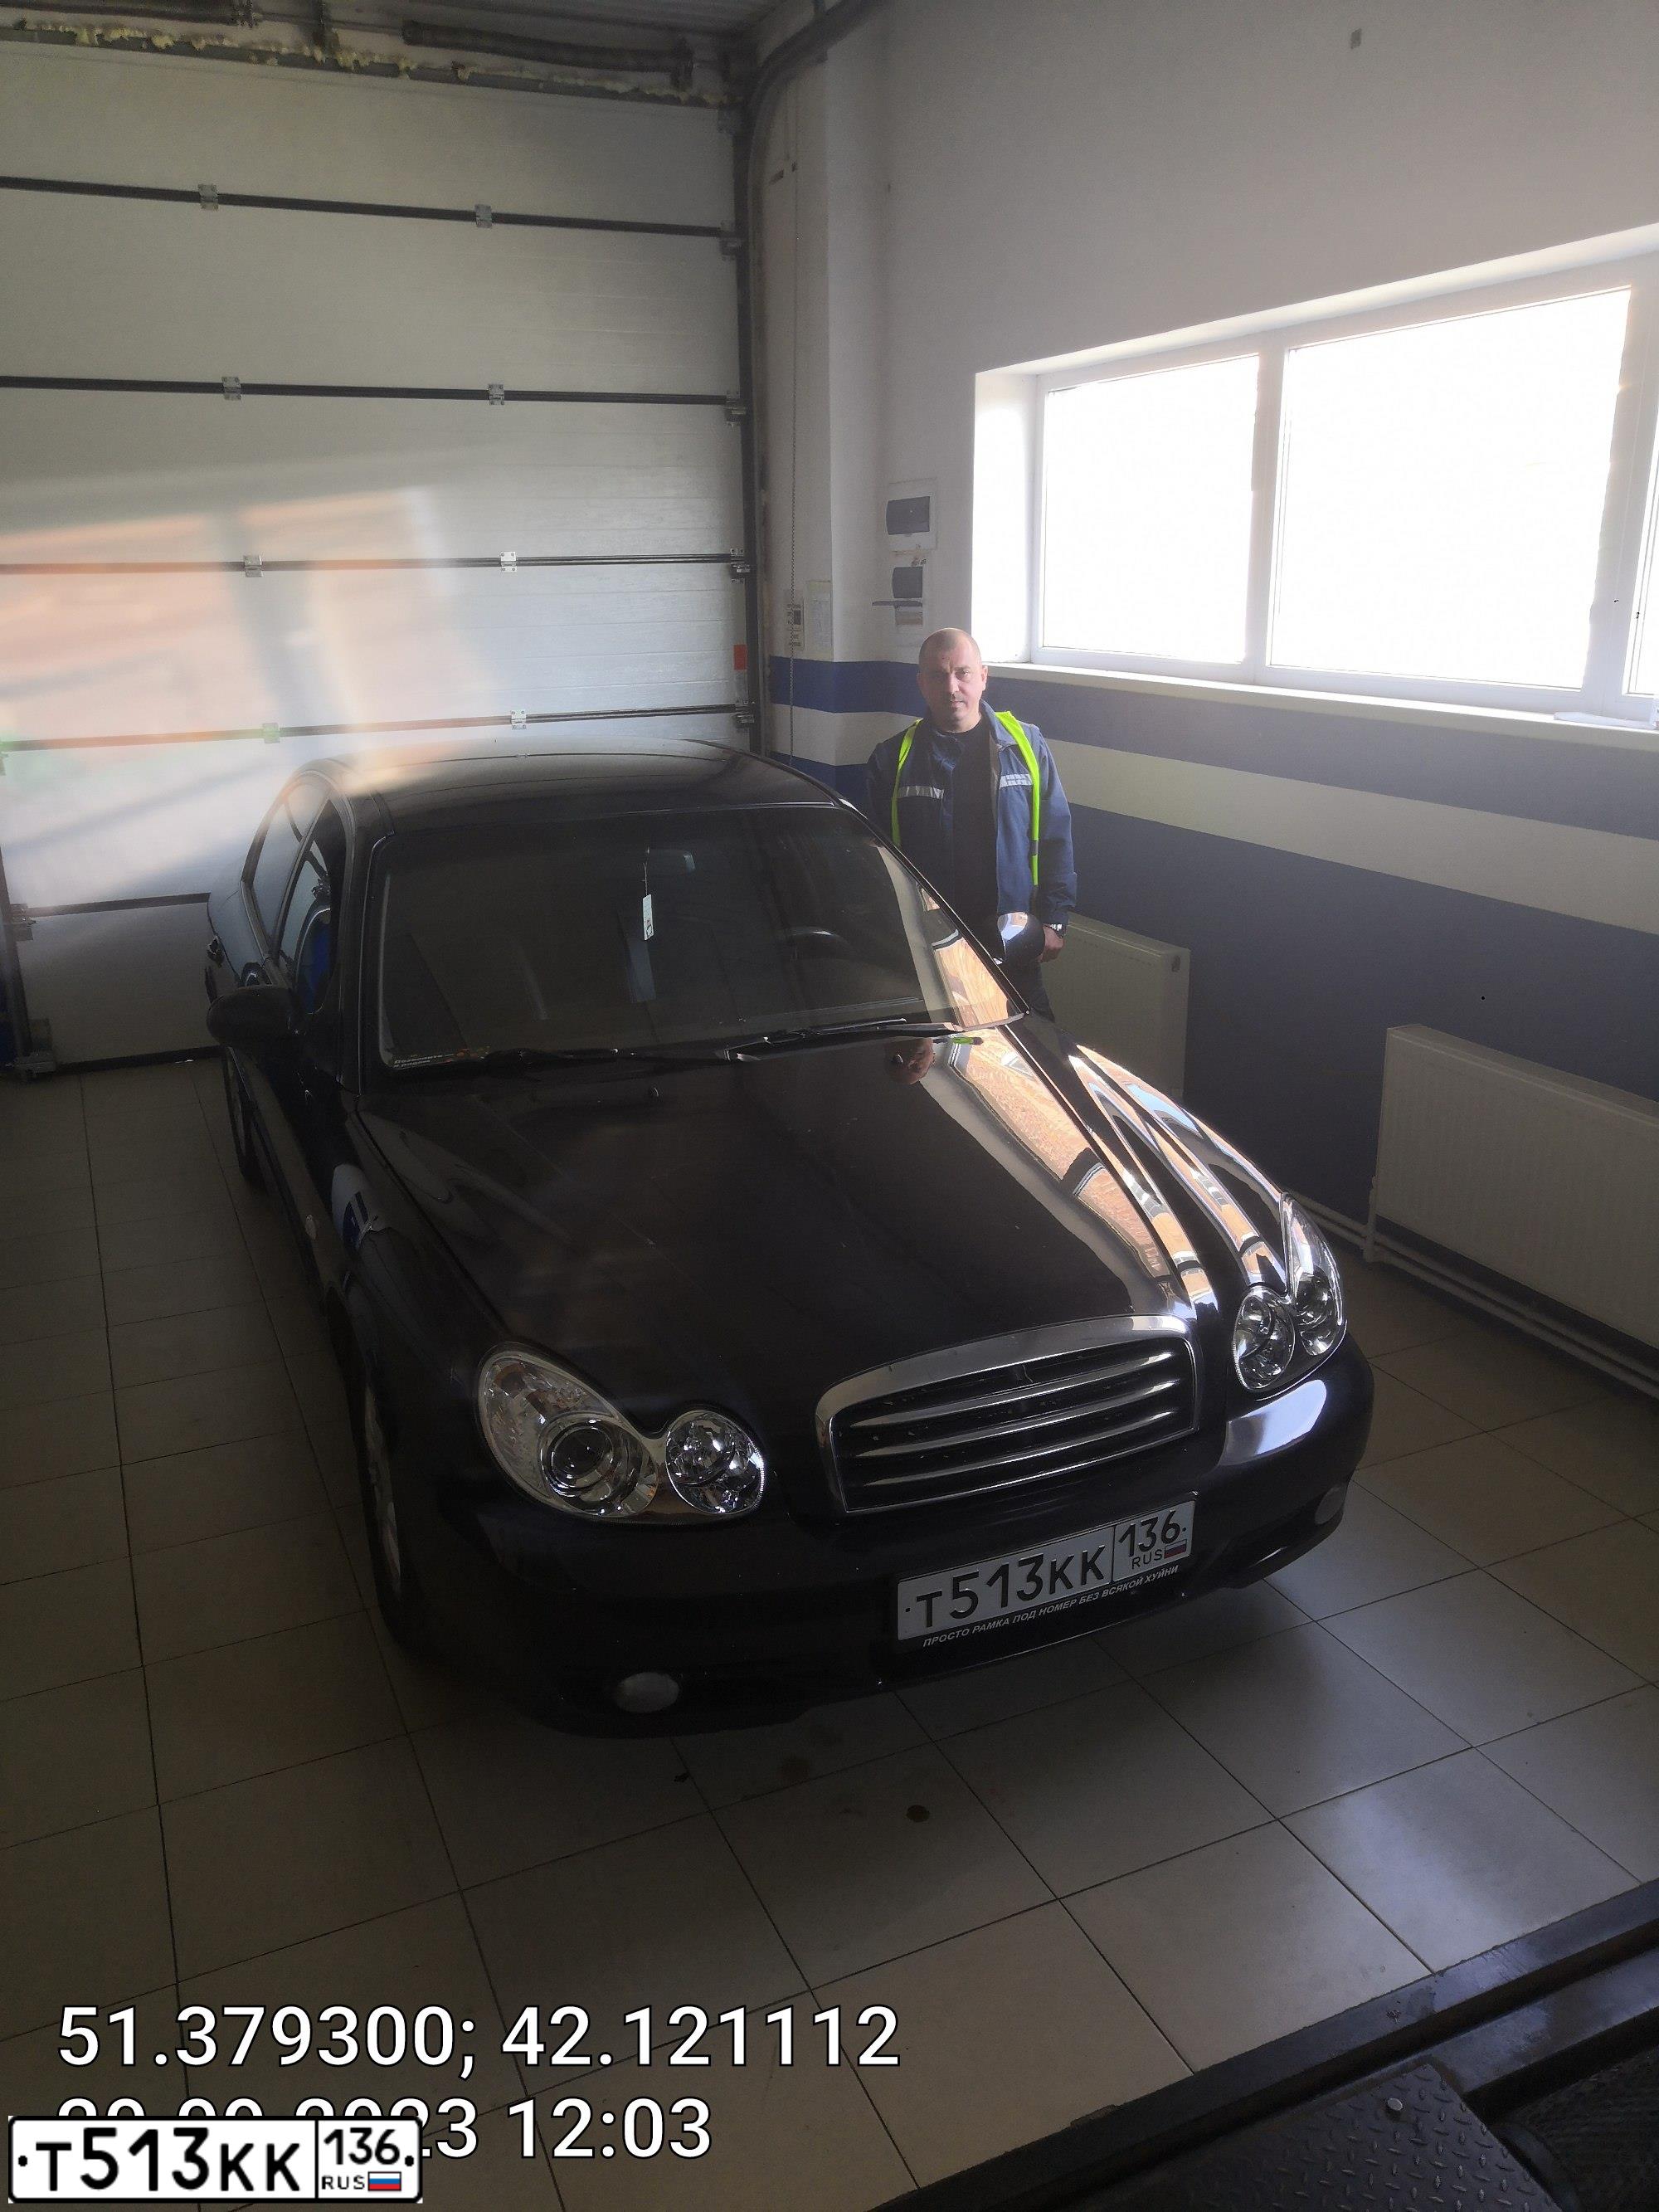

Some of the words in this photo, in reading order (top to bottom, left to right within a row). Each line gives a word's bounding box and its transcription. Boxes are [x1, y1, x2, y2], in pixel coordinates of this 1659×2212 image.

[1117, 1509, 1181, 1557] 136
[1131, 1549, 1162, 1570] RUS
[922, 1627, 971, 1648] ПРОСТО
[971, 1617, 1010, 1635] РАМКА
[1012, 1610, 1036, 1624] ПОД
[1038, 1599, 1078, 1616] НОМЕР
[1078, 1591, 1100, 1605] БЕЗ
[1102, 1580, 1144, 1598] ВСЯКОЙ
[1144, 1564, 1180, 1584] ХУЙНИ
